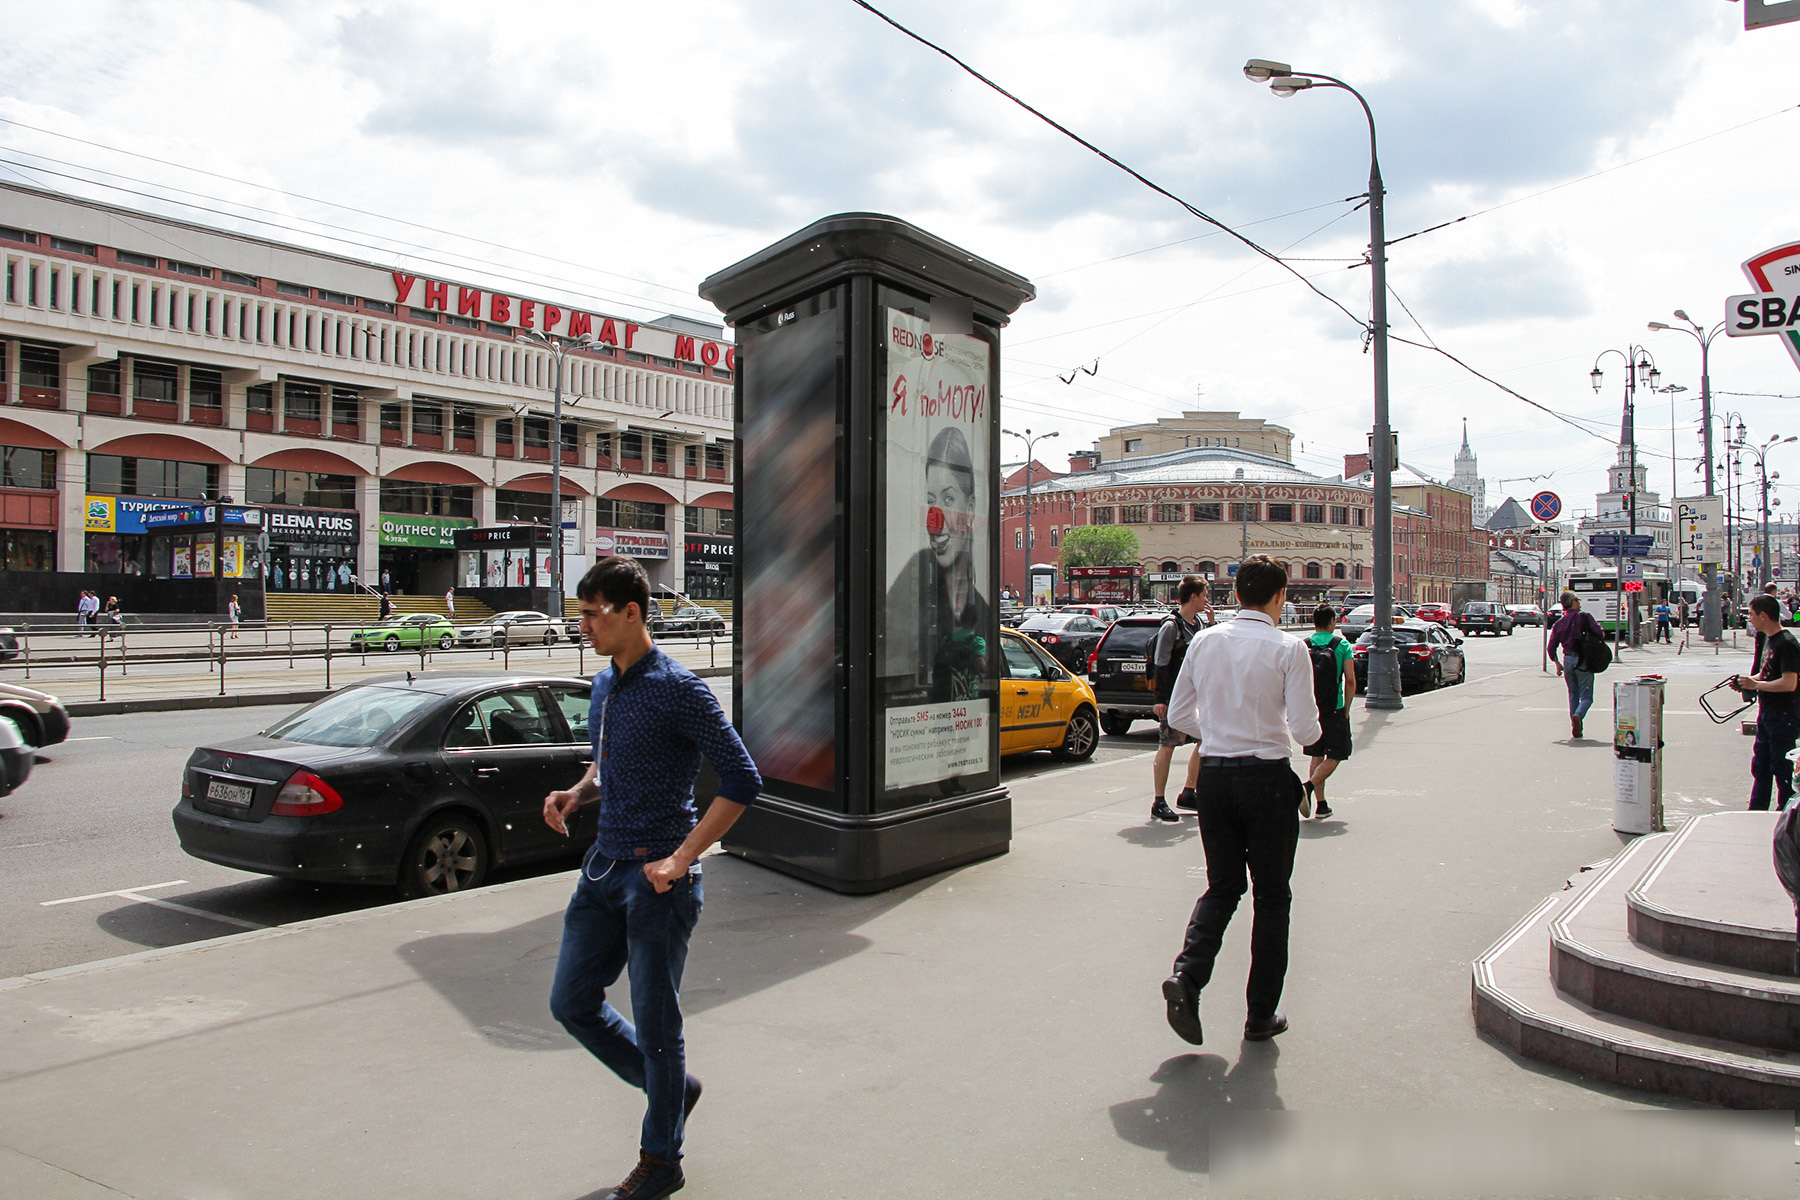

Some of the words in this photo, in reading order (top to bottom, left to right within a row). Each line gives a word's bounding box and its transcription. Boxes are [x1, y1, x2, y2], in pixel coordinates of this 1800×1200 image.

[392, 272, 639, 349] УНИВЕРМАГ
[891, 374, 908, 417] Я
[271, 513, 315, 529] ELENA
[317, 516, 353, 531] FURS
[382, 520, 437, 537] Фитнес
[271, 528, 312, 536] МЕХОВАЯ
[315, 529, 353, 537] ФАБРИКА
[916, 710, 929, 722] SMS
[936, 712, 952, 721] номер
[952, 707, 967, 718] 3443
[955, 719, 974, 731] НОСИК
[974, 717, 983, 728] 100
[238, 788, 251, 800] 161
